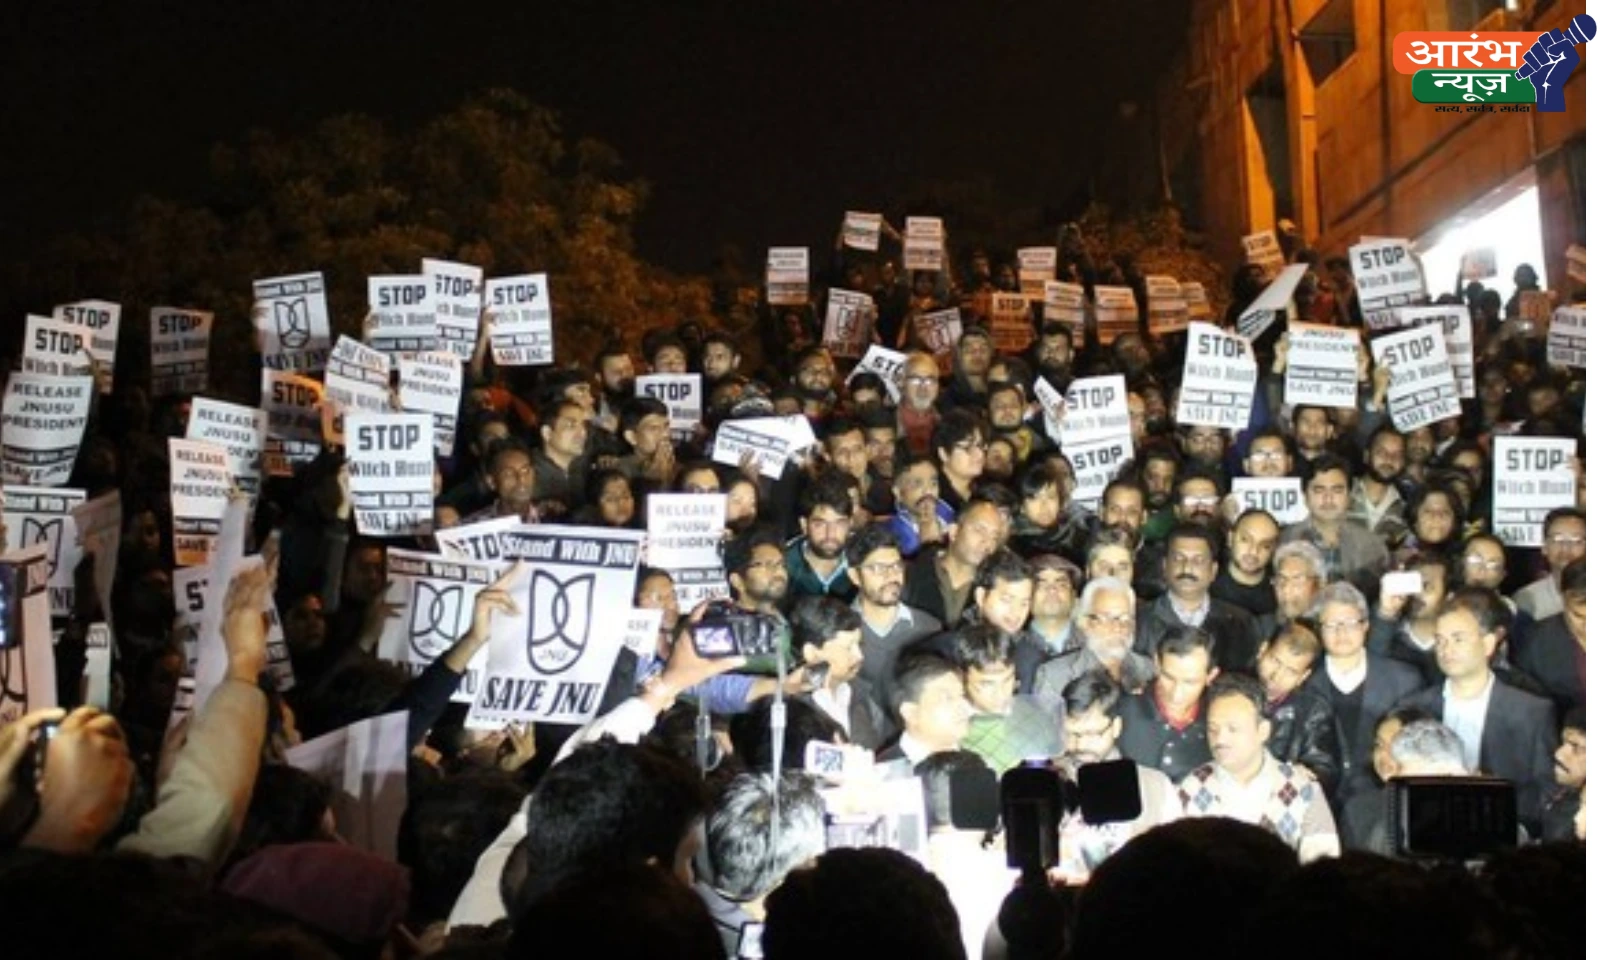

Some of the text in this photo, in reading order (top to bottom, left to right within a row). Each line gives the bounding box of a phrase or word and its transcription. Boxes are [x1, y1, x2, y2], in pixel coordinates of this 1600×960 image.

[1360, 247, 1405, 270] STOP
[378, 286, 426, 306] STOP
[494, 284, 538, 305] STOP
[62, 306, 110, 330] STOP
[159, 315, 205, 334] STOP
[35, 328, 83, 354] STOP
[1199, 334, 1246, 359] STOP
[1289, 340, 1358, 353] PRESIDENT
[1384, 336, 1435, 365] STOP
[14, 384, 83, 398] RELEASE
[272, 381, 319, 406] STOP
[644, 384, 691, 400] STOP
[1067, 387, 1114, 410] STOP
[1290, 382, 1321, 394] SAVE
[19, 402, 75, 414] JNUSU
[2, 416, 84, 430] PRESIDENT
[197, 408, 260, 430] RELEASE
[203, 427, 251, 442] JNUSU
[358, 425, 420, 451] STOP
[175, 449, 226, 466] RELEASE
[1073, 445, 1123, 470] STOP
[1506, 448, 1564, 471] STOP
[184, 468, 222, 481] JNUSU
[350, 460, 390, 478] Witch
[655, 503, 717, 517] RELEASE
[1245, 490, 1298, 511] STOP
[502, 534, 637, 566] Stand With JNU
[482, 677, 545, 711] SAVE
[546, 681, 601, 716] JNU
